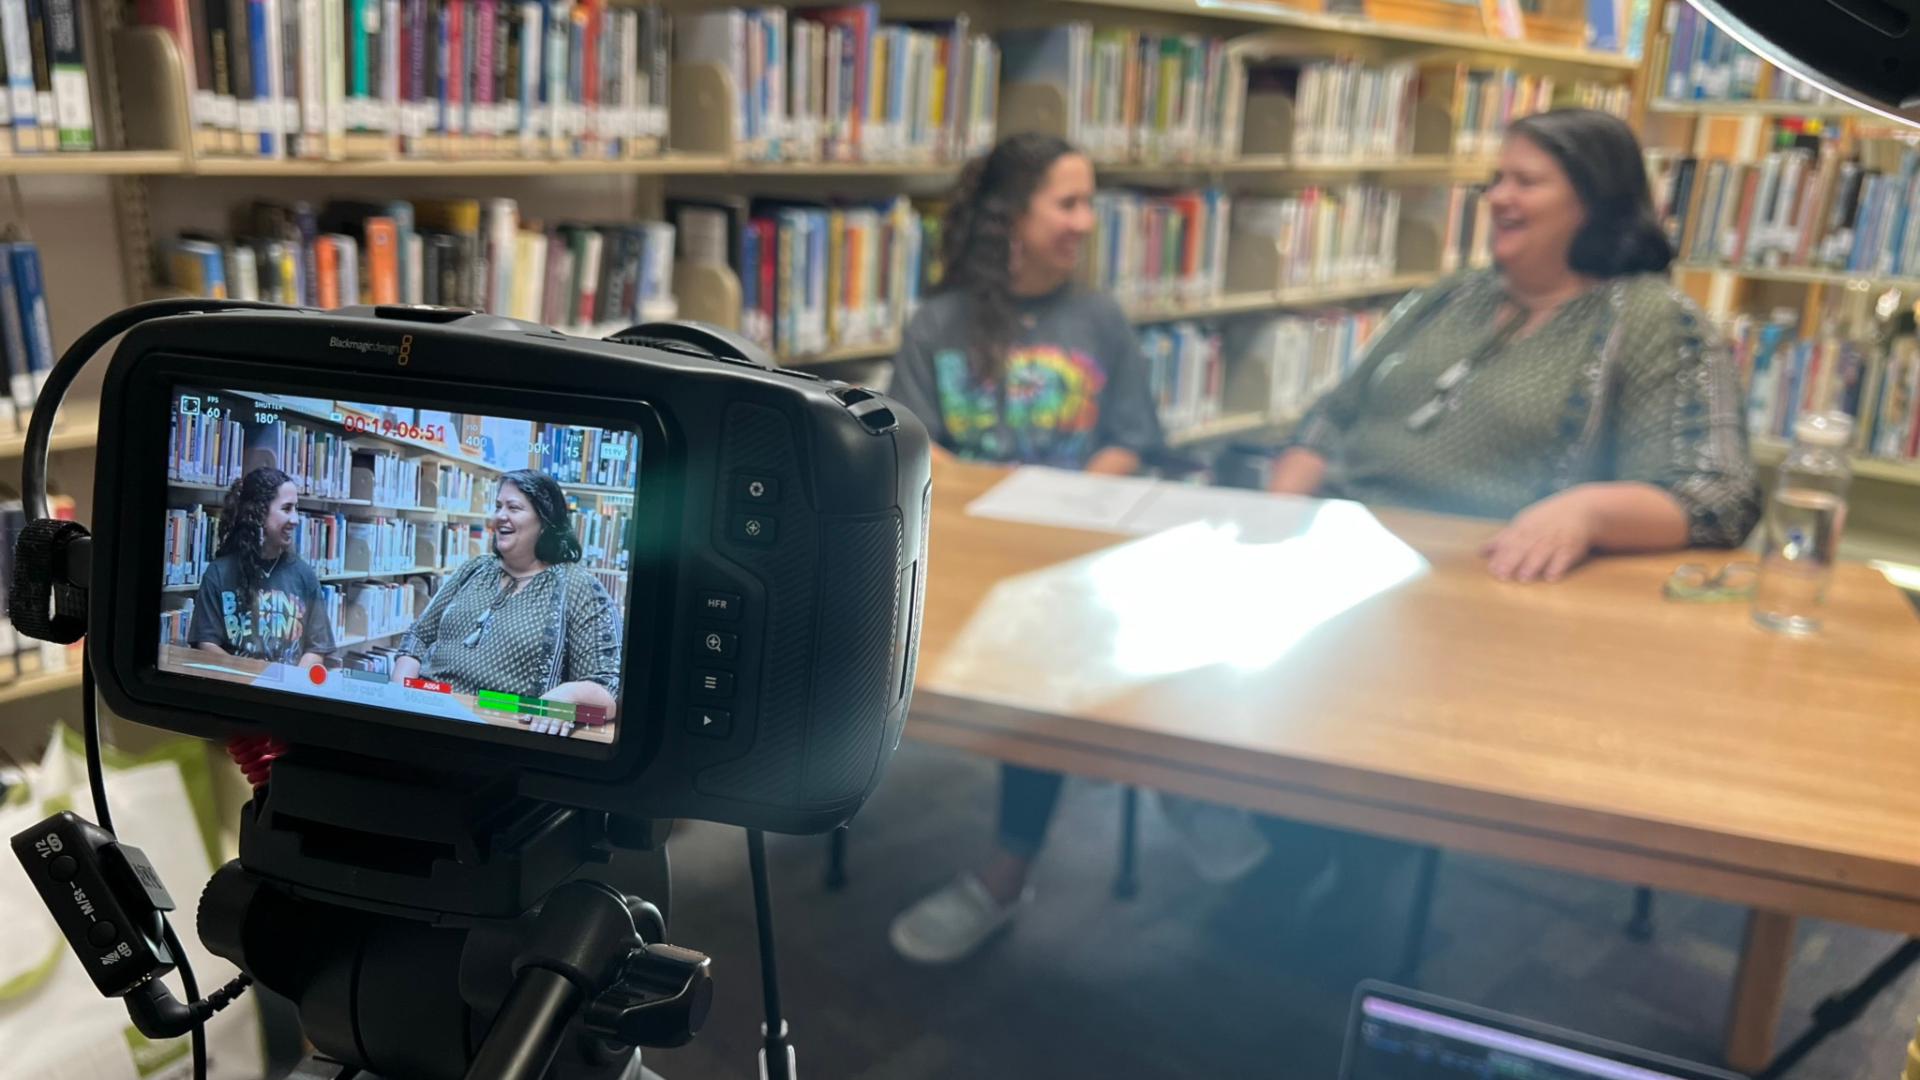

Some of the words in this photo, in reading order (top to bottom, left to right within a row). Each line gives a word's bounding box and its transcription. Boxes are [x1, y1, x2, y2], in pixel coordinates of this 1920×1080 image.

[206, 395, 220, 404] FPS
[254, 401, 284, 411] SHUTTER
[206, 407, 221, 419] 60
[344, 414, 445, 443] 00:19:06:51
[465, 423, 479, 432] ISO
[465, 435, 488, 448] 400
[566, 434, 583, 443] TINT
[565, 446, 580, 458] 15
[258, 588, 306, 618] KIND
[708, 599, 727, 609] HFR
[224, 611, 252, 640] BE
[258, 611, 304, 640] KIND
[35, 839, 51, 858] 1/2
[118, 942, 132, 957] dB
